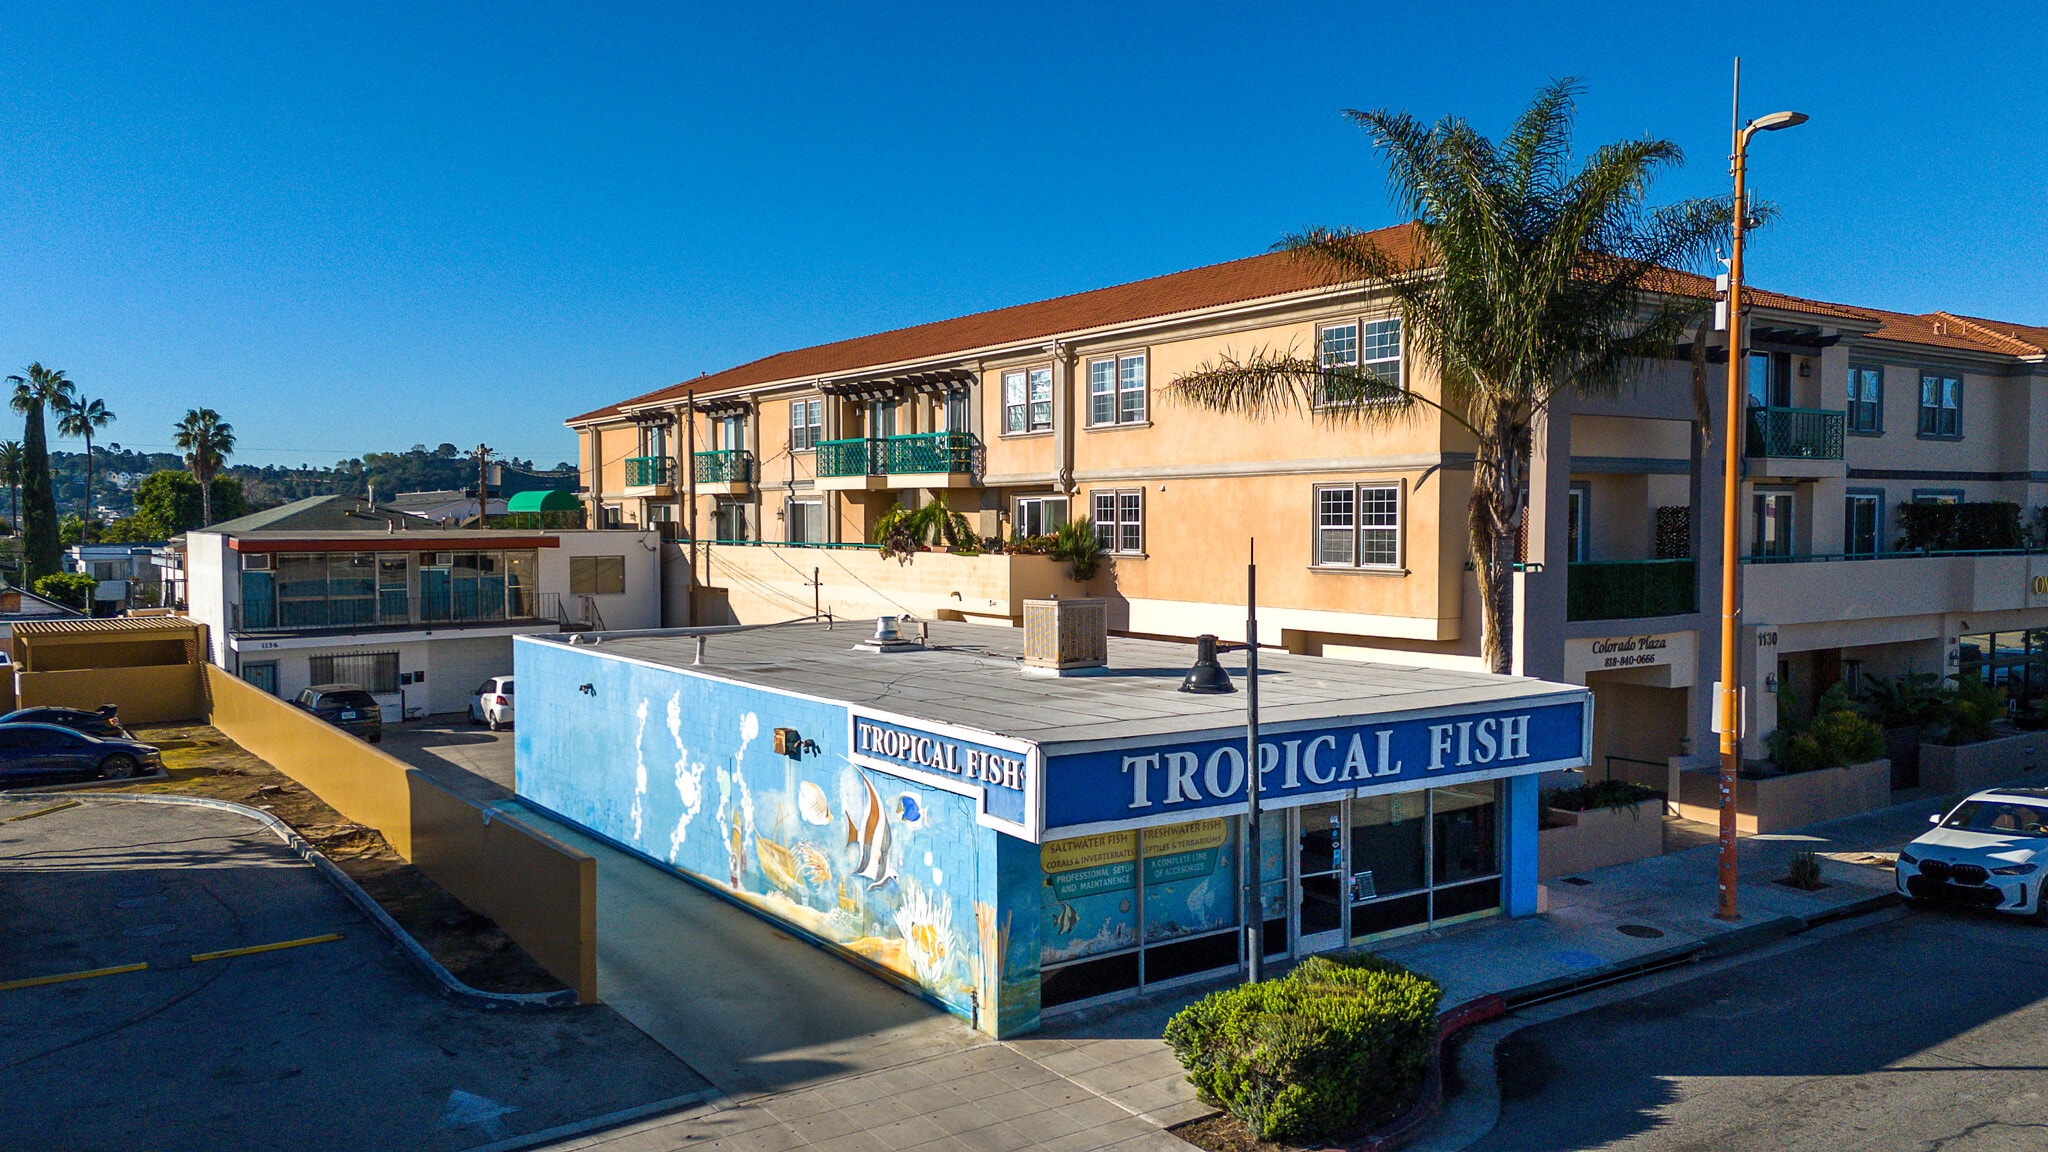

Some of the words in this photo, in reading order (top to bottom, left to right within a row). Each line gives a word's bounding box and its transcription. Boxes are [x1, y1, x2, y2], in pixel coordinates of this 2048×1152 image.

[1592, 637, 1636, 654] Colorado
[1638, 635, 1667, 651] Plaza
[1757, 631, 1778, 646] 1130
[859, 722, 961, 774] TROPICAL
[965, 748, 1024, 791] FISH
[1121, 730, 1402, 809] TROPICAL
[1427, 714, 1531, 770] FISH
[1144, 823, 1200, 840] FRESHWATER
[1202, 819, 1221, 831] FISH
[1050, 837, 1105, 853] SALTWATER
[1107, 833, 1128, 846] FISH
[1178, 835, 1222, 849] TERRARIUMS
[1046, 858, 1074, 870] CORALS
[1074, 857, 1080, 865] &
[1081, 849, 1135, 864] INVERTEBRATES
[1151, 860, 1158, 868] A
[1158, 854, 1191, 867] COMPLETE
[1192, 851, 1208, 861] LINE
[1056, 867, 1109, 883] PROFESSIONAL
[1112, 864, 1135, 875] SETUP
[1154, 869, 1163, 878] OF
[1165, 863, 1205, 877] ACCESORIES
[1061, 884, 1077, 894] AND
[1080, 875, 1130, 890] MAINTANENCE
